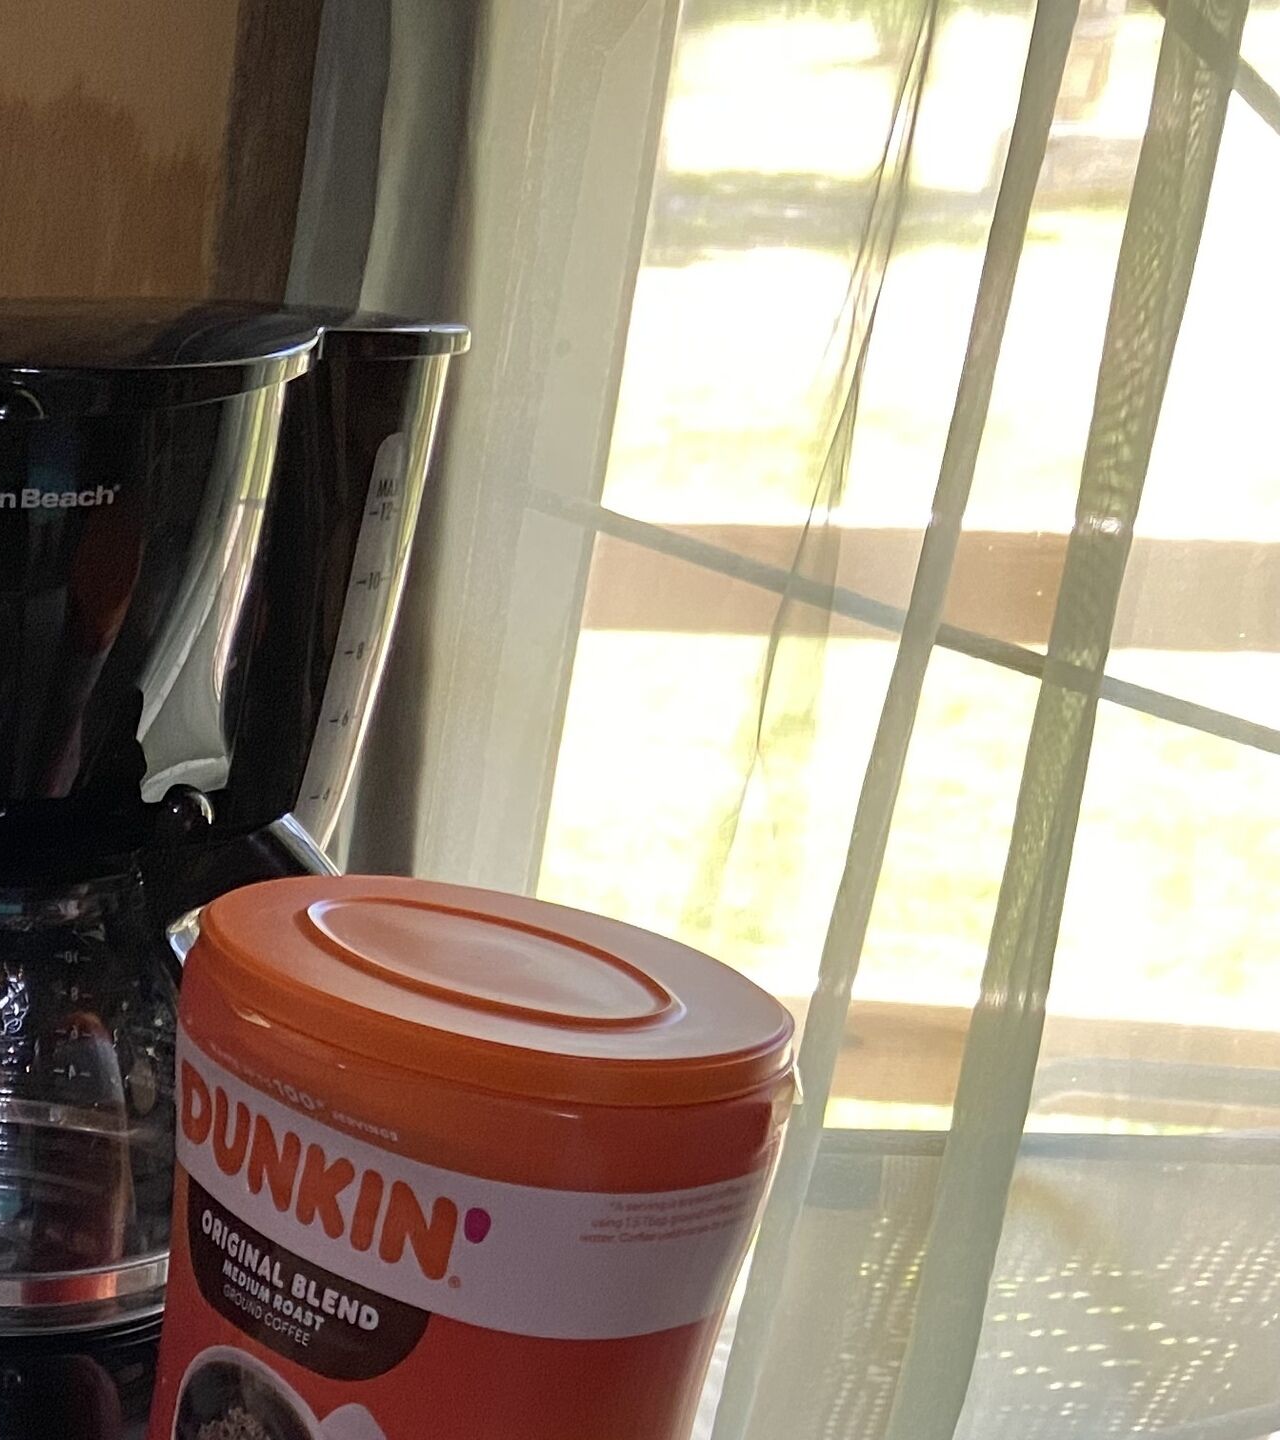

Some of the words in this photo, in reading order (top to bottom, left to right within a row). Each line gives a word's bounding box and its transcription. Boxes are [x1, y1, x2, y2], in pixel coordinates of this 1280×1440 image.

[21, 485, 115, 508] Beach
[201, 1208, 284, 1289] ORIGINAL
[291, 1273, 380, 1332] BLEND
[222, 1259, 270, 1304] MEDIUM
[273, 1295, 325, 1332] ROAST
[222, 1283, 263, 1321] GROUND
[264, 1309, 311, 1347] COFFEE
